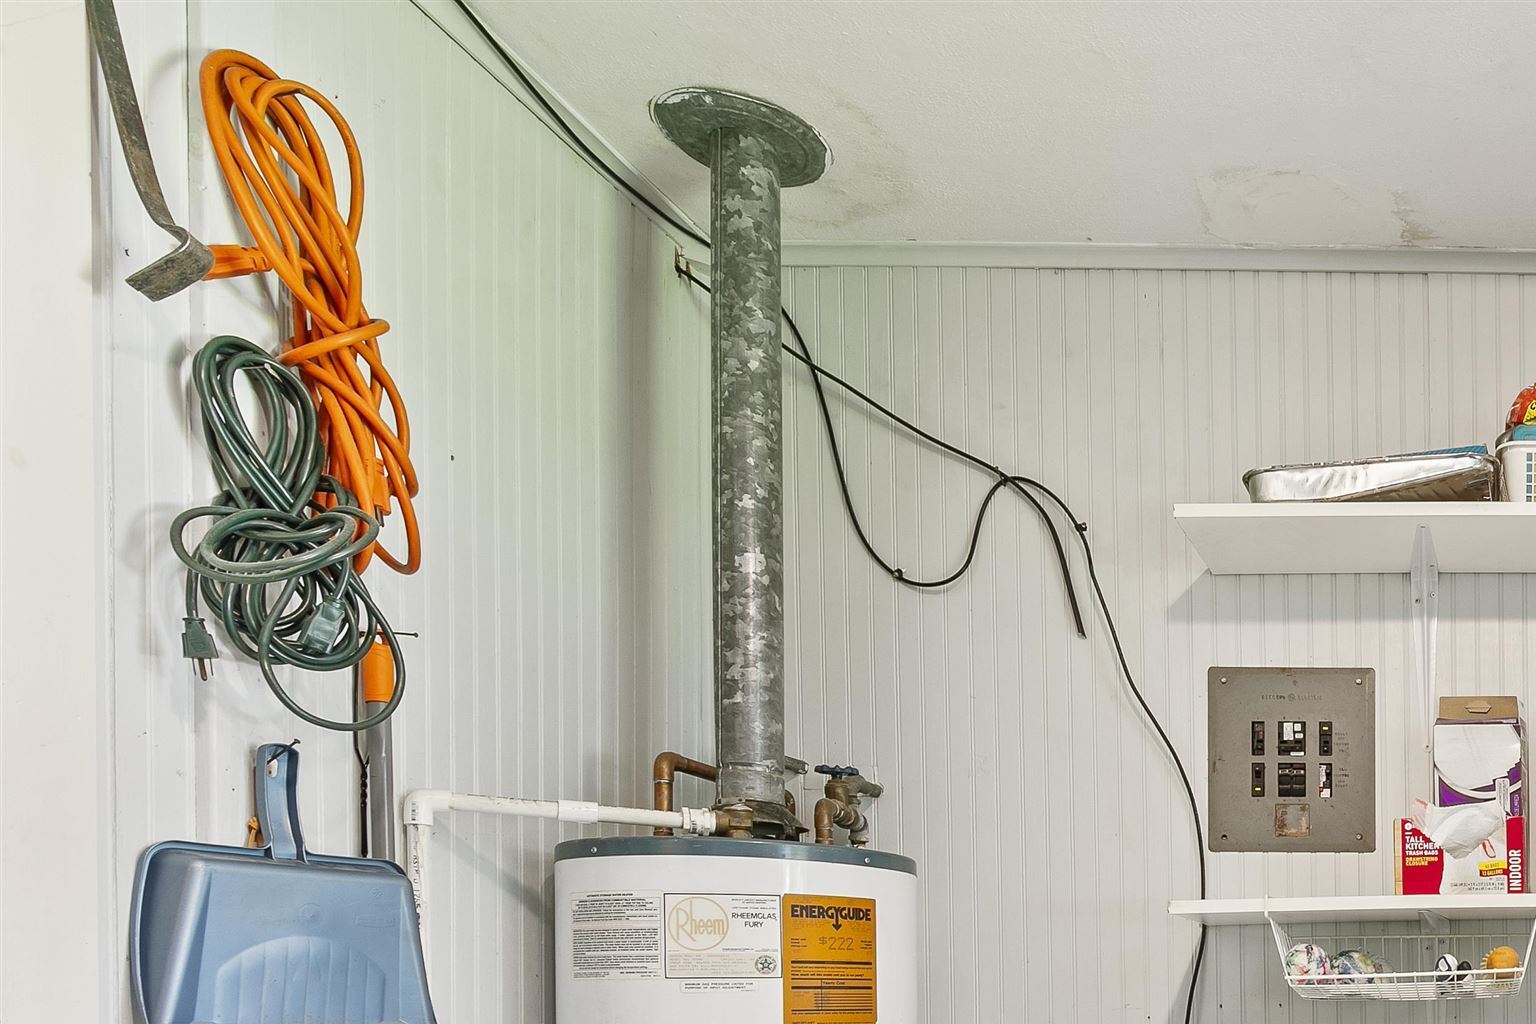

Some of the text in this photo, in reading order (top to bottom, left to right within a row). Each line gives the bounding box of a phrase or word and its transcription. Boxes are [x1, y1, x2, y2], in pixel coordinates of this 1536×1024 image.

[1405, 842, 1440, 850] KITCHEN
[1508, 849, 1522, 891] INDOOR
[676, 900, 725, 942] Rheem
[731, 912, 777, 920] RHEEMGLAS
[791, 904, 872, 923] ENERGYGUIDE
[819, 937, 854, 951] $222
